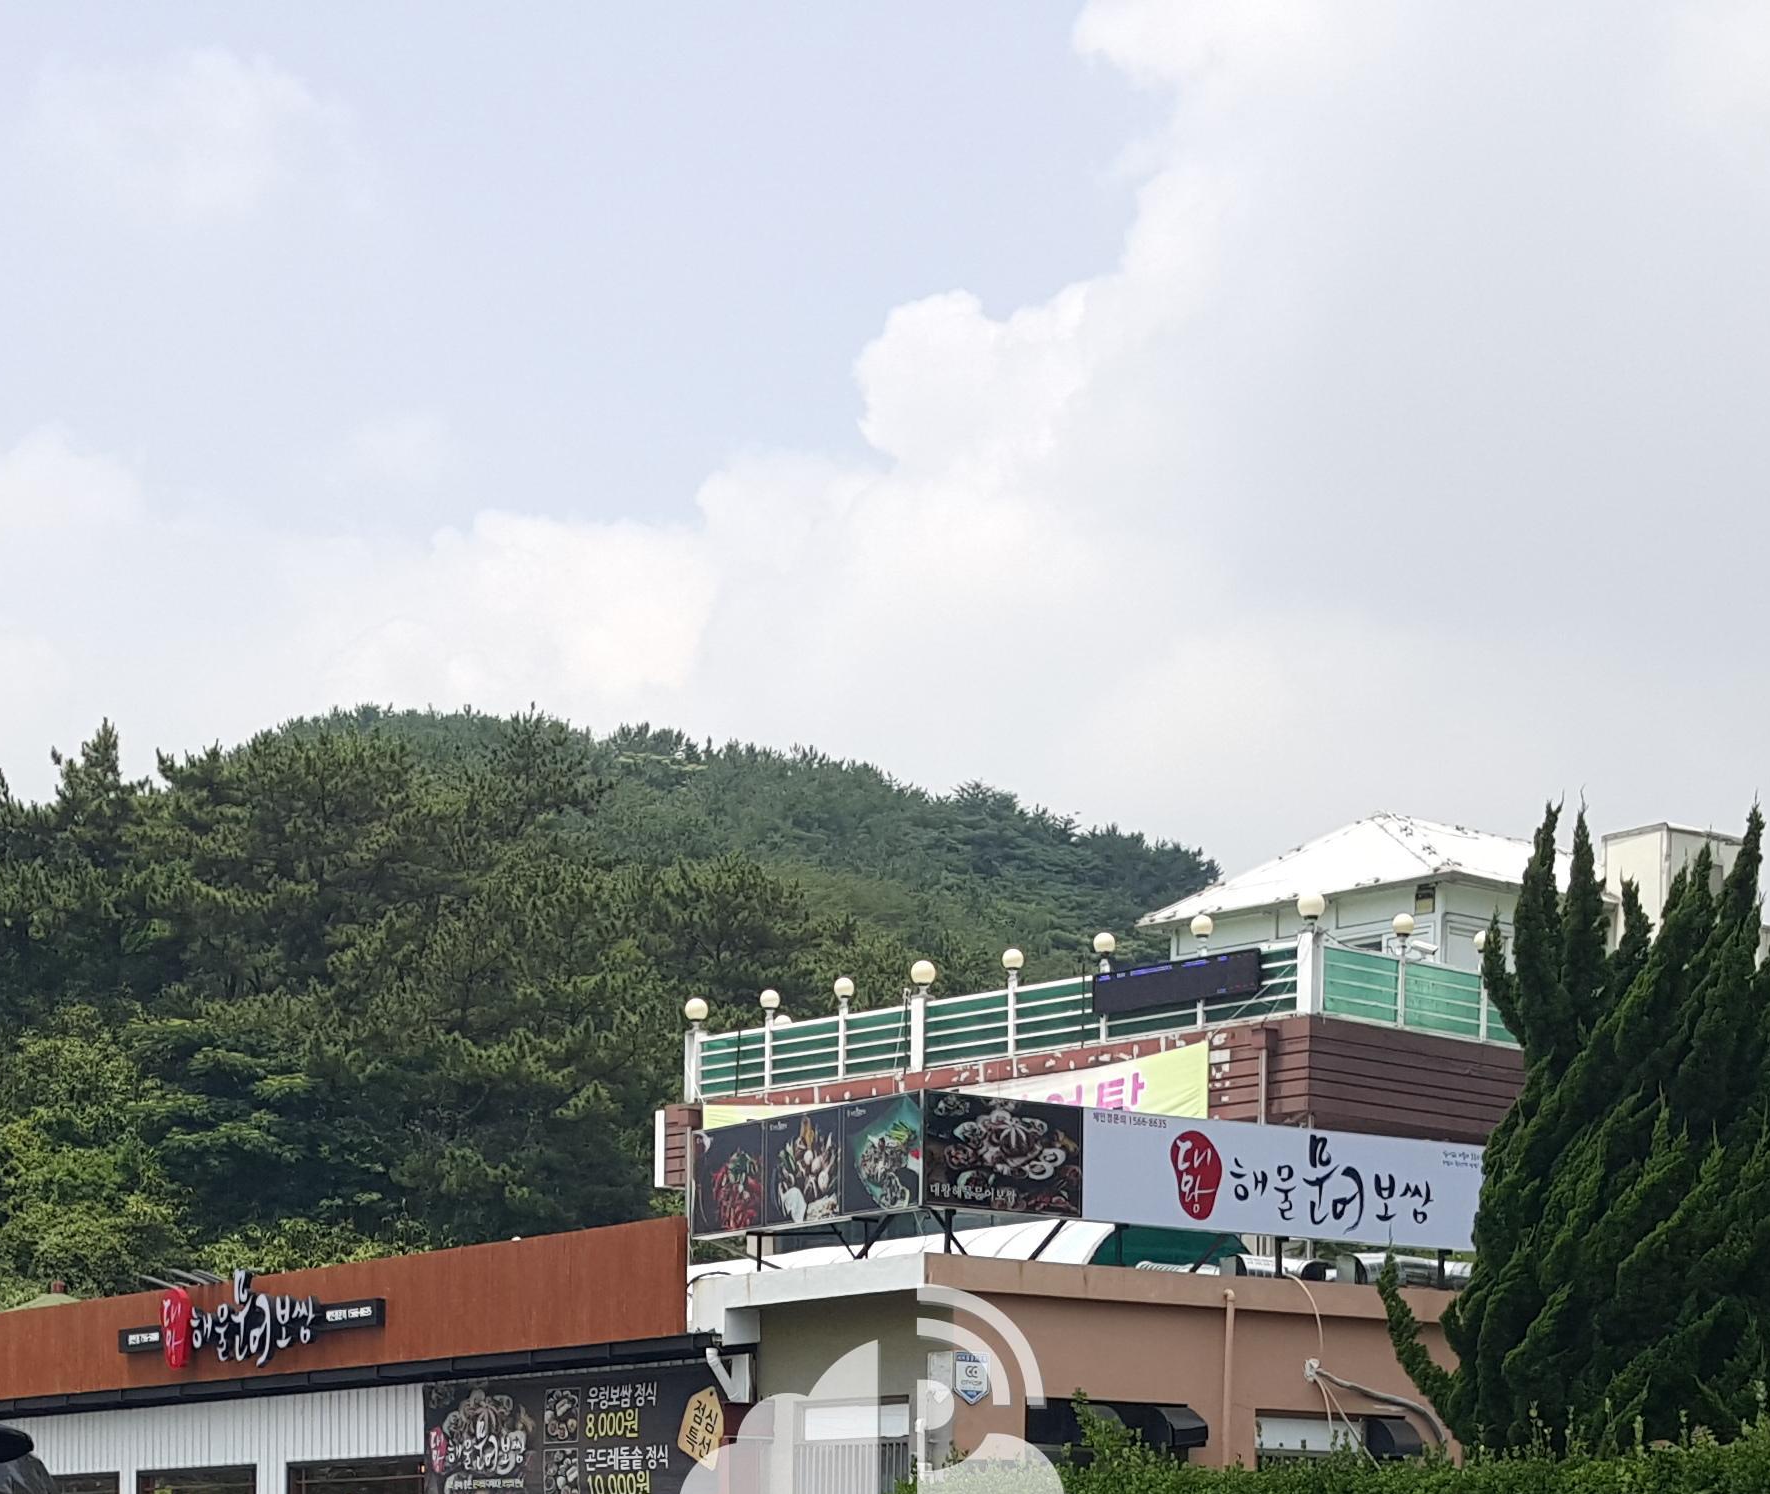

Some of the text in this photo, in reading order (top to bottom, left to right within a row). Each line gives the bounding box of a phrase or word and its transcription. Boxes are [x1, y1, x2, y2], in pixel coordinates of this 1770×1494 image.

[587, 1382, 657, 1410] 우렁보쌈 정식
[585, 1408, 639, 1441] 8,000원
[693, 1400, 719, 1435] 점심
[646, 1444, 669, 1469] 정식
